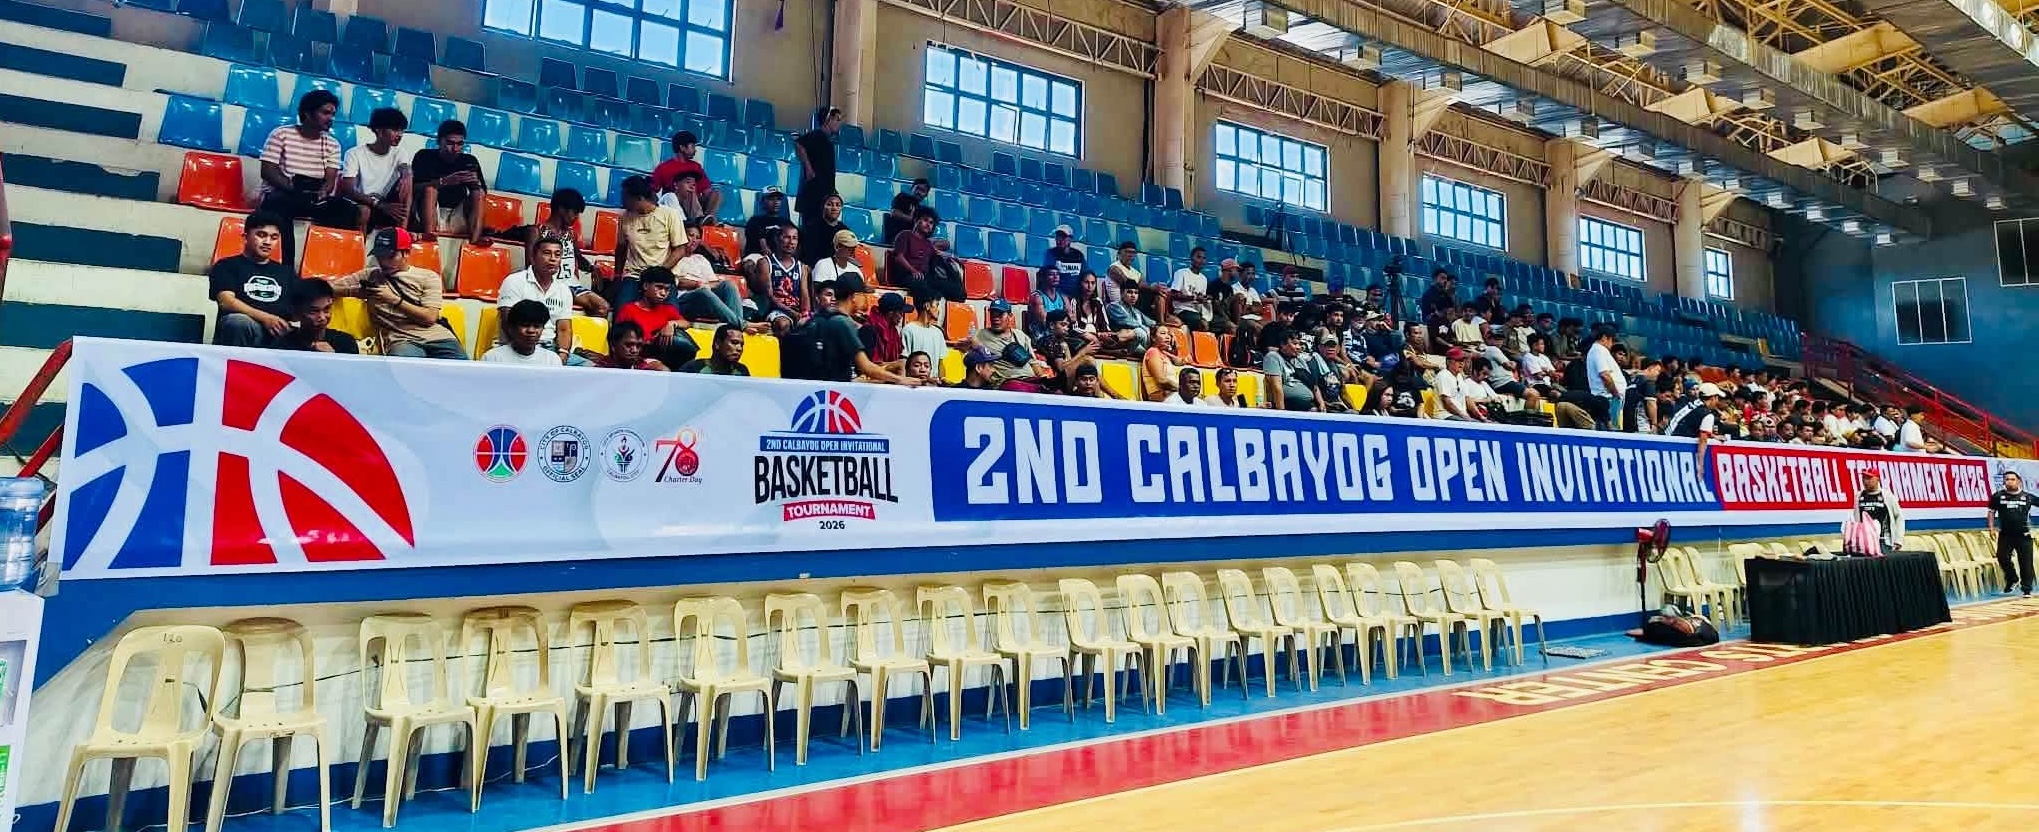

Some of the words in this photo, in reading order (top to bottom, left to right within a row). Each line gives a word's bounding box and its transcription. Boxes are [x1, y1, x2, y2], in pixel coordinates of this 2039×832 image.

[655, 429, 700, 482] 78
[766, 439, 781, 450] 2ND
[820, 440, 839, 451] OPEN
[840, 440, 886, 452] INVITATIONAL
[963, 416, 1102, 505] 2ND
[1126, 423, 1394, 504] CALBAYOG
[1406, 436, 1509, 502] OPEN
[1515, 441, 1717, 503] INVITATIONAL
[663, 475, 688, 483] Charter
[688, 475, 703, 485] Day
[754, 455, 899, 505] BASKETBALL
[1716, 452, 1848, 503] BASKETBALL
[1846, 459, 1951, 502] TRNAMENT
[1951, 464, 1989, 502] 2026
[786, 503, 871, 519] TOURNAMENT
[819, 520, 846, 530] 2026
[1450, 659, 1728, 706] CENTER
